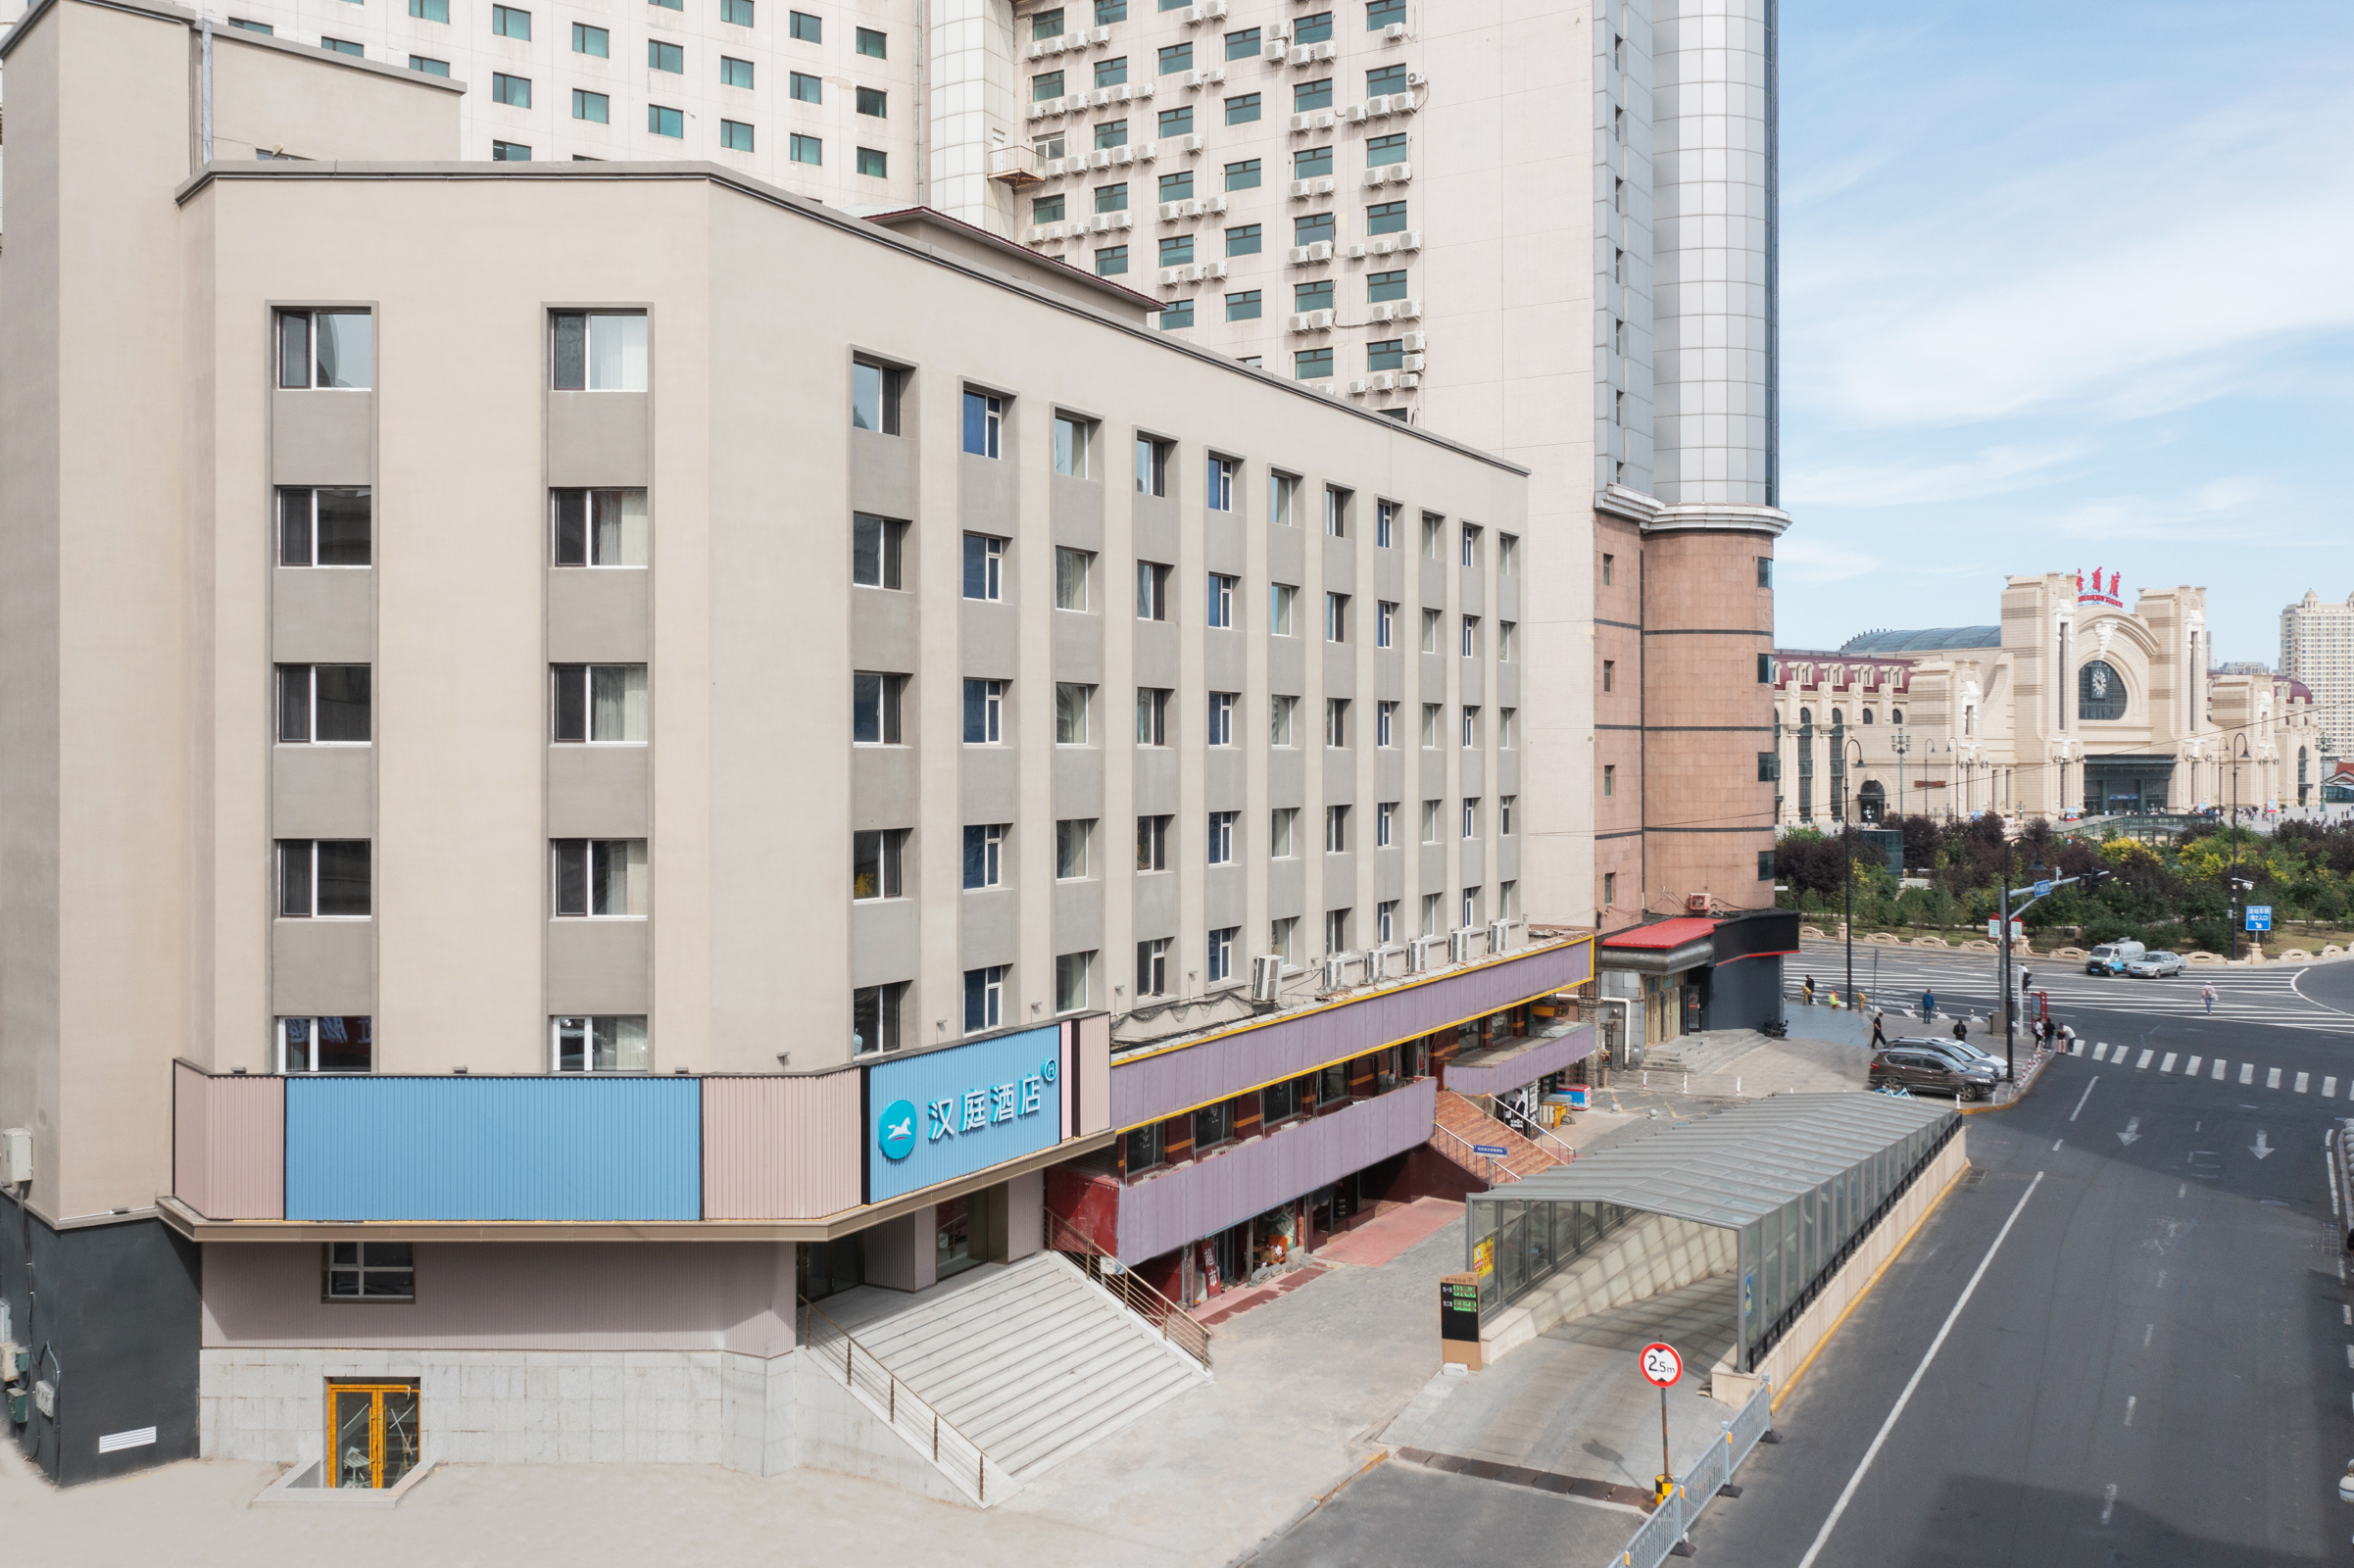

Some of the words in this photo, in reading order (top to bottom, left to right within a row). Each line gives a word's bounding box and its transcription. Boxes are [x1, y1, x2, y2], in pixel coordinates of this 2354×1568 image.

[928, 1074, 1041, 1141] 汉庭酒店
[1203, 1248, 1217, 1287] 超市
